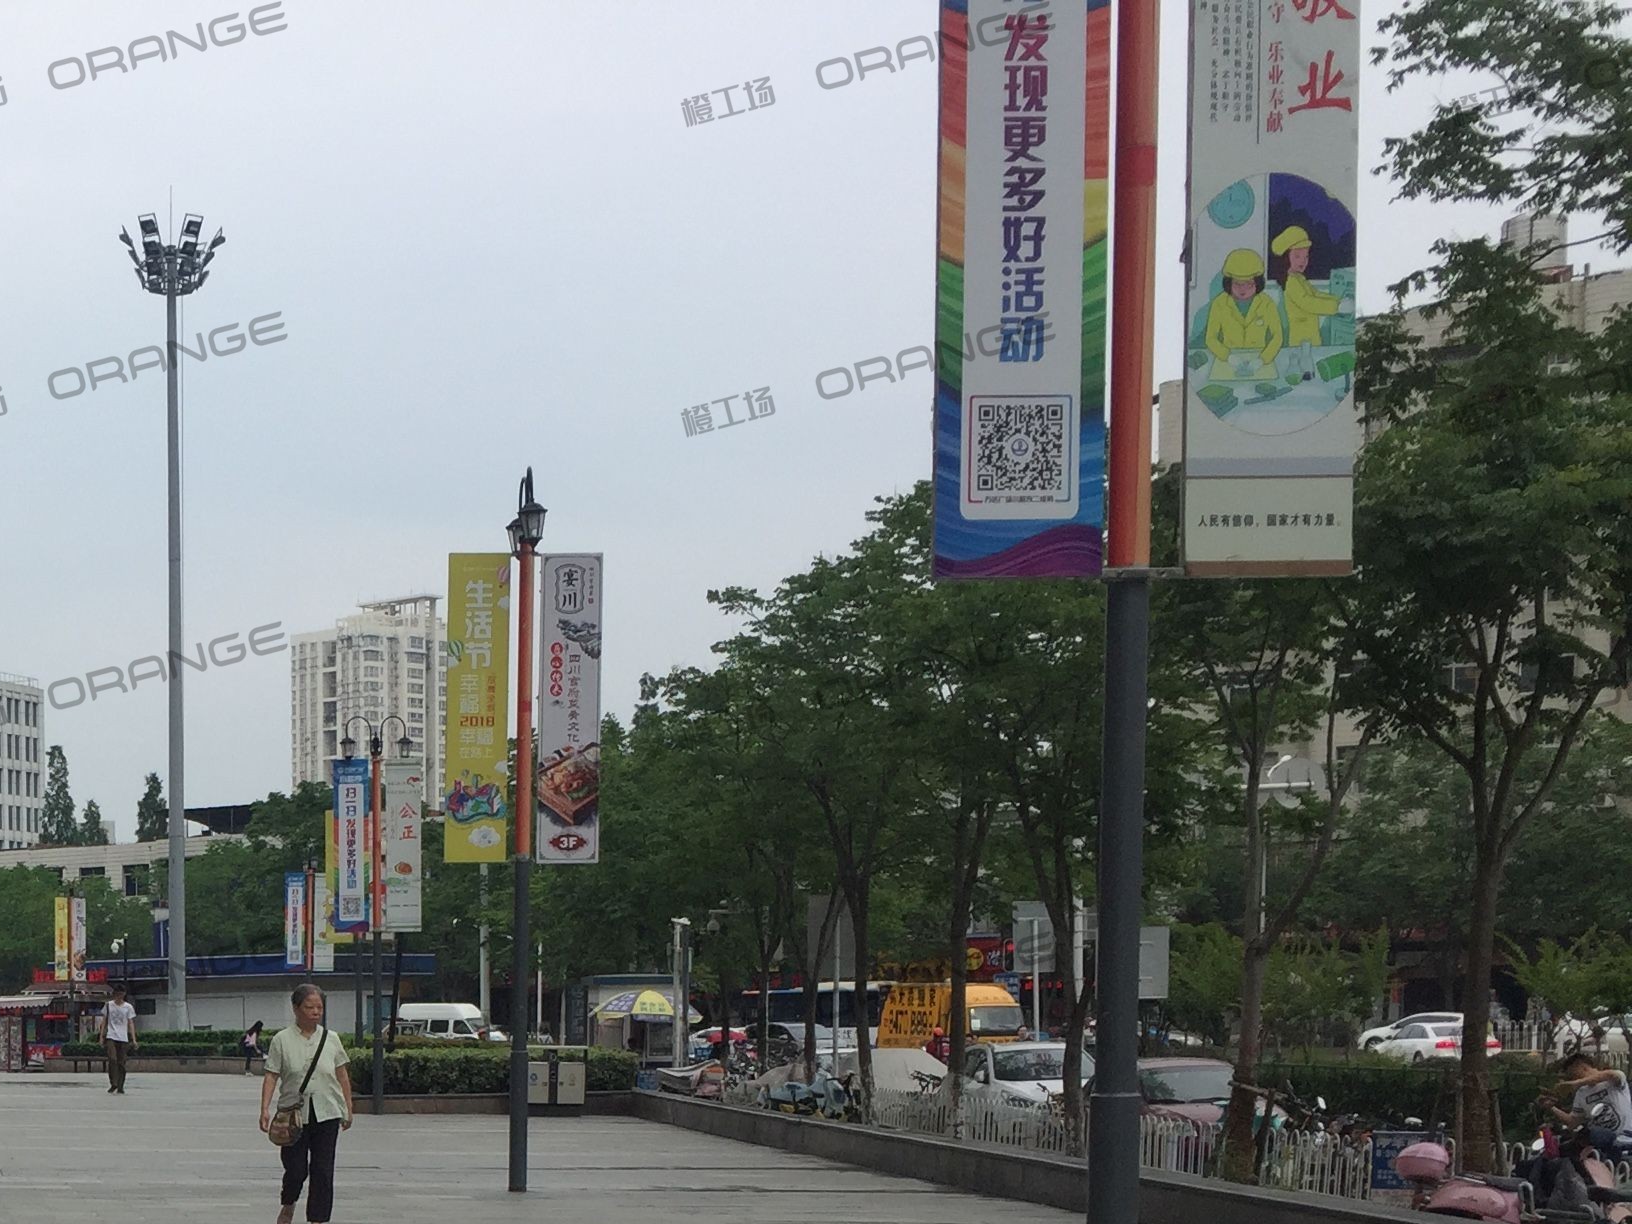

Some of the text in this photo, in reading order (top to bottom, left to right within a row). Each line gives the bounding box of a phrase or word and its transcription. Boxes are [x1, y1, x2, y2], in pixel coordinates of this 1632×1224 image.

[1266, 40, 1285, 134] 乐业奉献
[998, 12, 1049, 364] 发现更多好活动
[465, 579, 494, 670] 生活节
[459, 715, 495, 727] 2018
[399, 802, 418, 841] 公正
[560, 836, 578, 849] 3F
